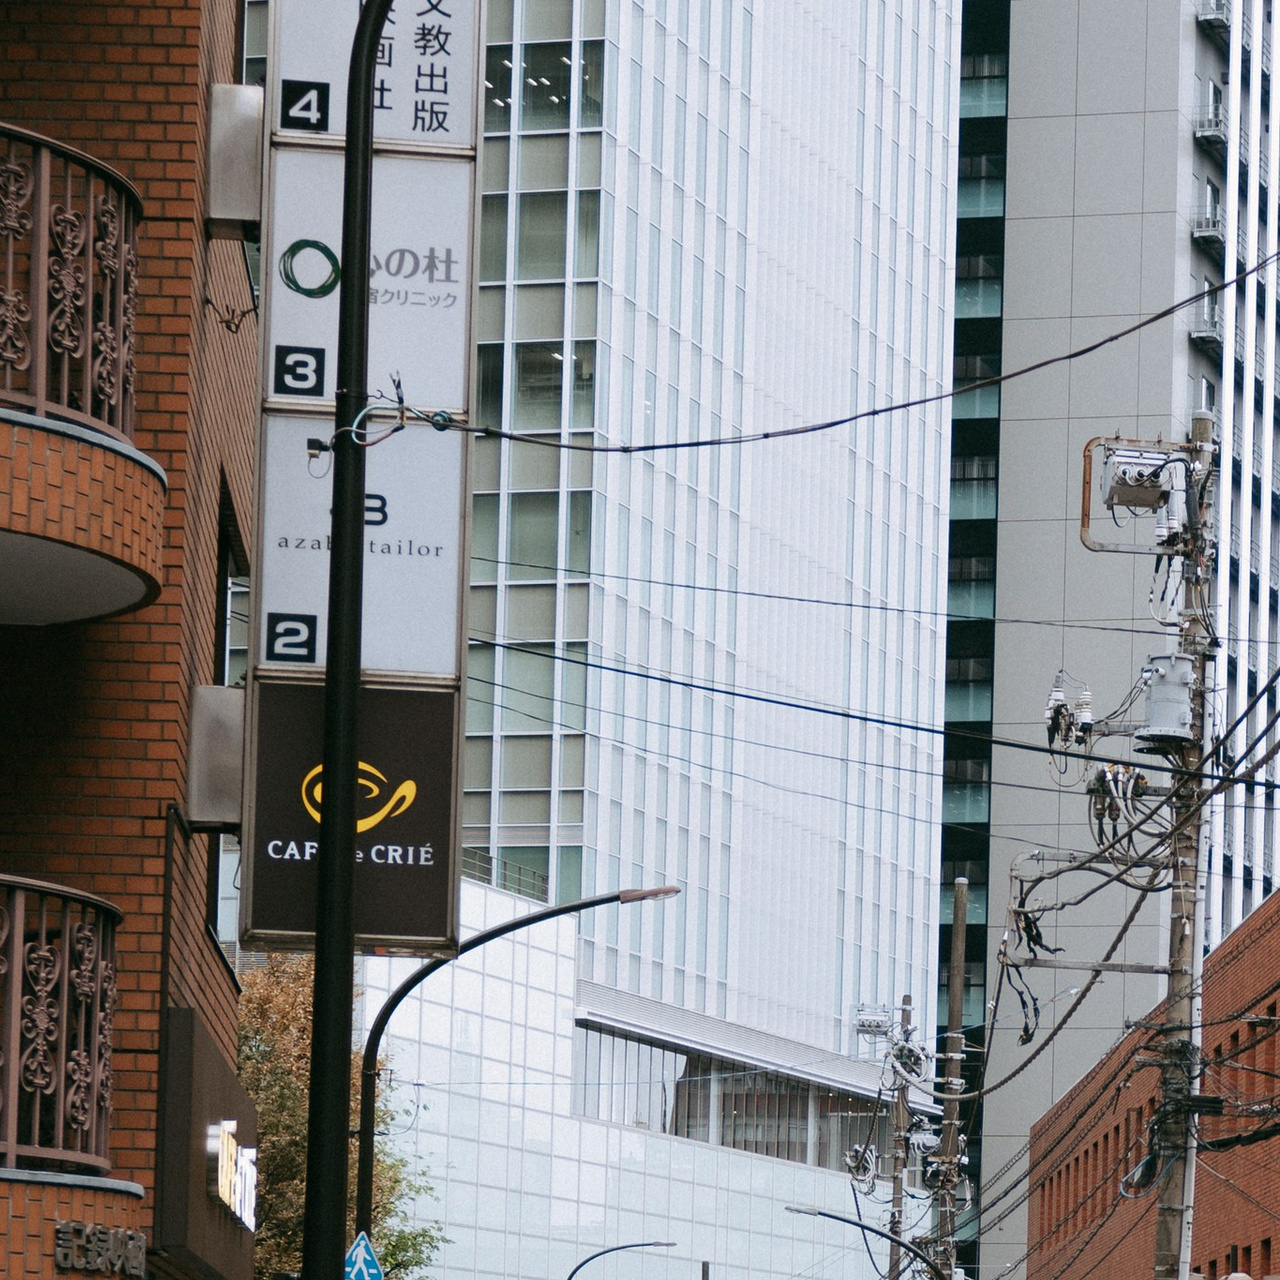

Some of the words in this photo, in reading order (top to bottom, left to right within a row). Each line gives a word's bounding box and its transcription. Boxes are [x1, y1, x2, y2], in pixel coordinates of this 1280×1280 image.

[288, 88, 321, 125] 4
[283, 353, 317, 390] 3
[278, 535, 333, 551] aza
[369, 540, 443, 557] tailor
[273, 620, 309, 656] 2
[267, 840, 319, 860] CAF
[370, 843, 434, 866] CRIÉ
